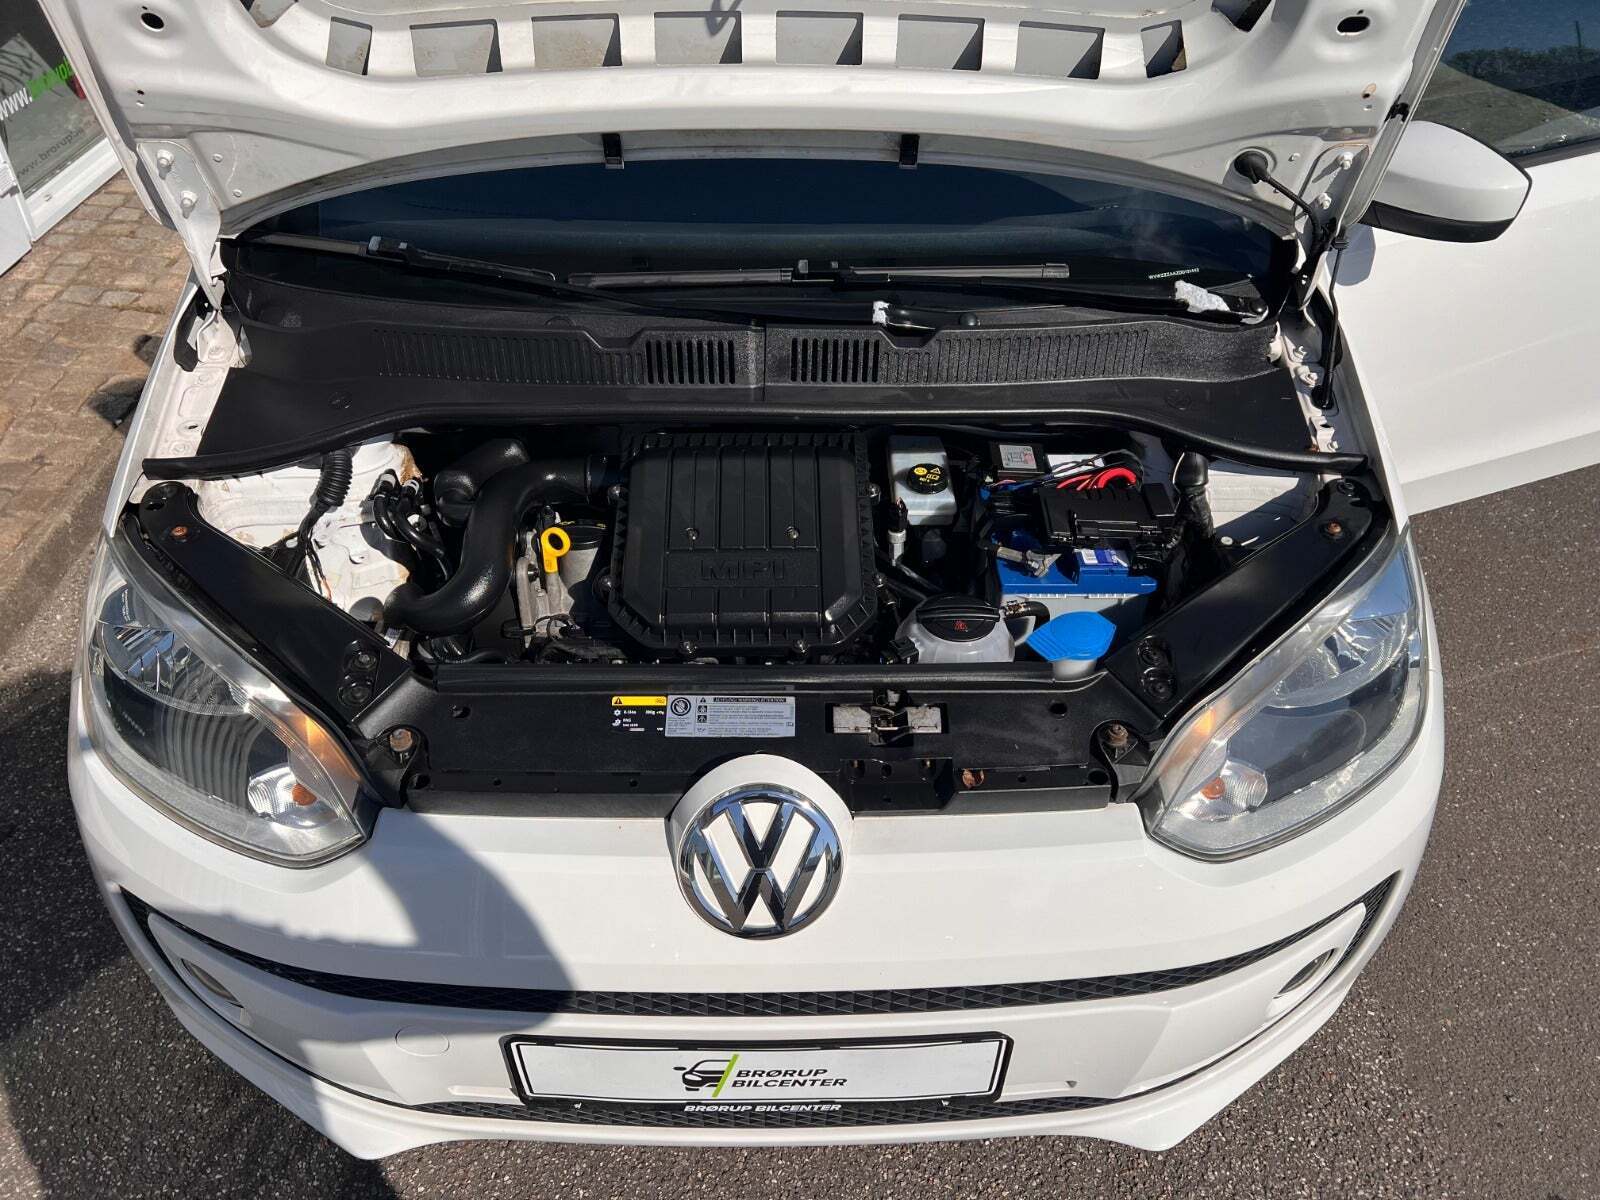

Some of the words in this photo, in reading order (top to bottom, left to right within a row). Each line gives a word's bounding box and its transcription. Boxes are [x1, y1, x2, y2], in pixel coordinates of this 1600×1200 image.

[700, 559, 785, 581] MPI
[735, 1068, 828, 1078] BRØRUP
[731, 1078, 848, 1088] BILCENTER
[755, 1104, 842, 1112] BILCENTER
